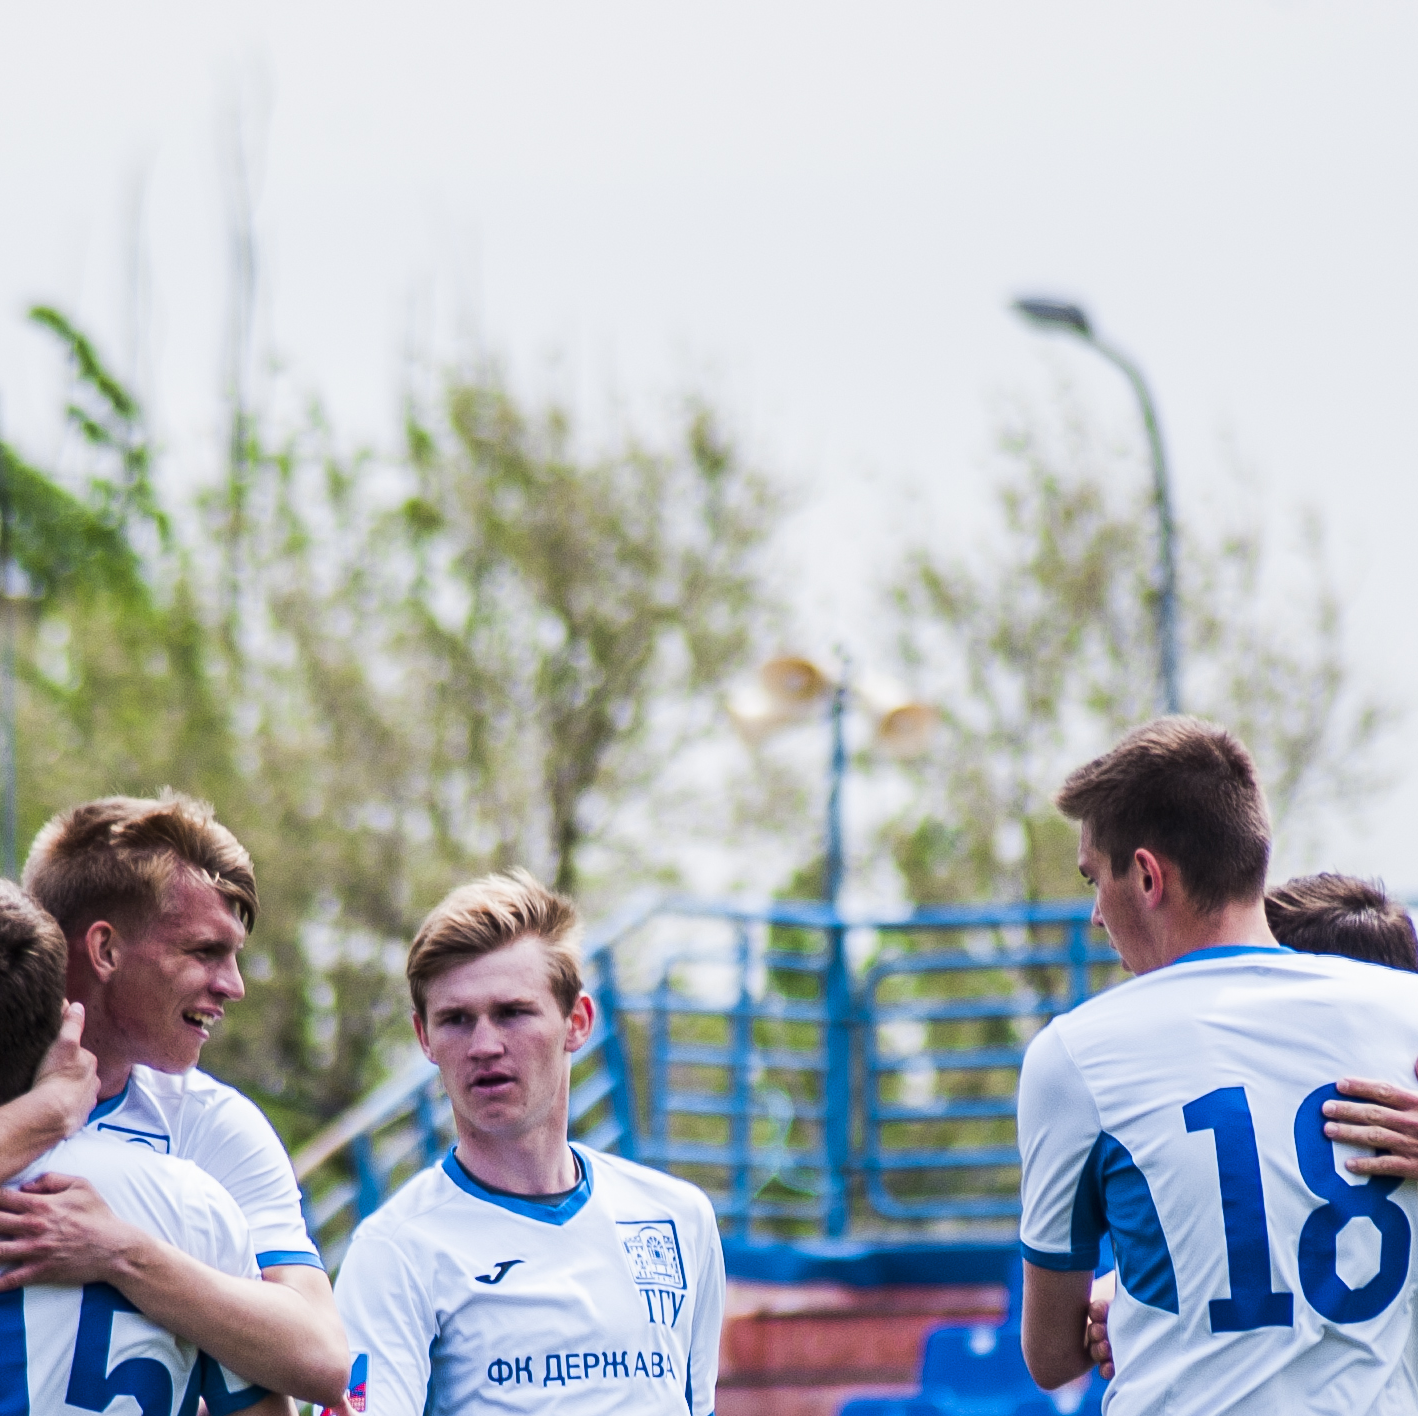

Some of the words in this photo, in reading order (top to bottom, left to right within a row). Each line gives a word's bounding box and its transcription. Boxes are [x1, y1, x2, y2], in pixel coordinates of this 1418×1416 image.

[1183, 1082, 1412, 1333] 18
[639, 1288, 686, 1328] ТГУ
[487, 1356, 533, 1386] ФК
[543, 1350, 676, 1387] ДЕРЖАВА
